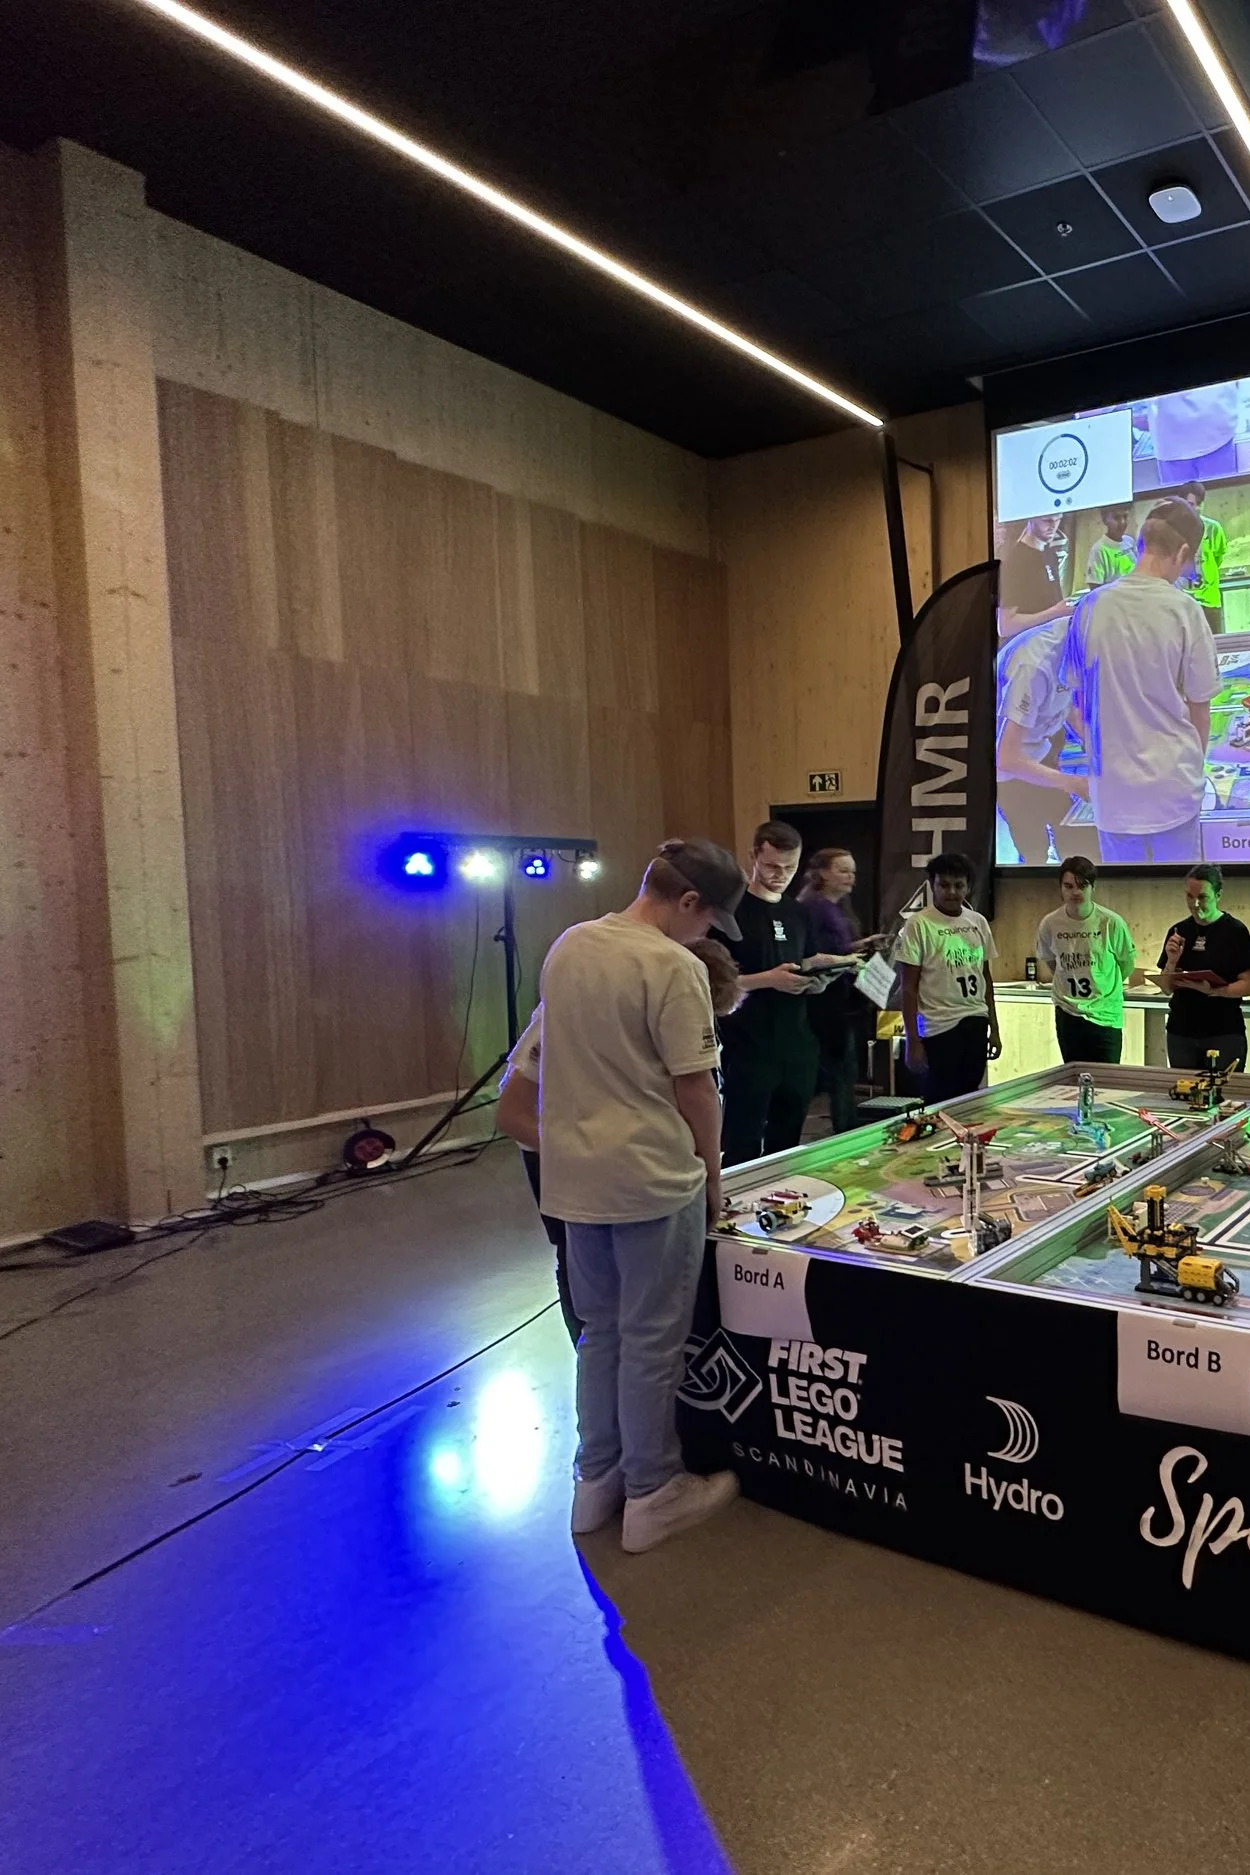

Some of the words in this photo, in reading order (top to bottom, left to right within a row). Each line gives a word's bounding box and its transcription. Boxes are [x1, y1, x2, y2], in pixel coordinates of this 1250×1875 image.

[1049, 457, 1078, 470] 00:02:02
[911, 676, 971, 868] HMR
[938, 926, 972, 937] equinor
[1057, 931, 1092, 941] equinor
[956, 974, 978, 998] 13
[1067, 977, 1093, 998] 13
[734, 1264, 769, 1287] Bord
[773, 1272, 785, 1290] A
[767, 1338, 867, 1384] FIRST
[1147, 1339, 1200, 1370] Bord
[1208, 1350, 1222, 1373] B
[769, 1373, 859, 1421] LEGO
[774, 1408, 905, 1473] LEAGUE
[731, 1441, 908, 1511] SCANDINAVIA
[964, 1462, 1065, 1521] Hydro
